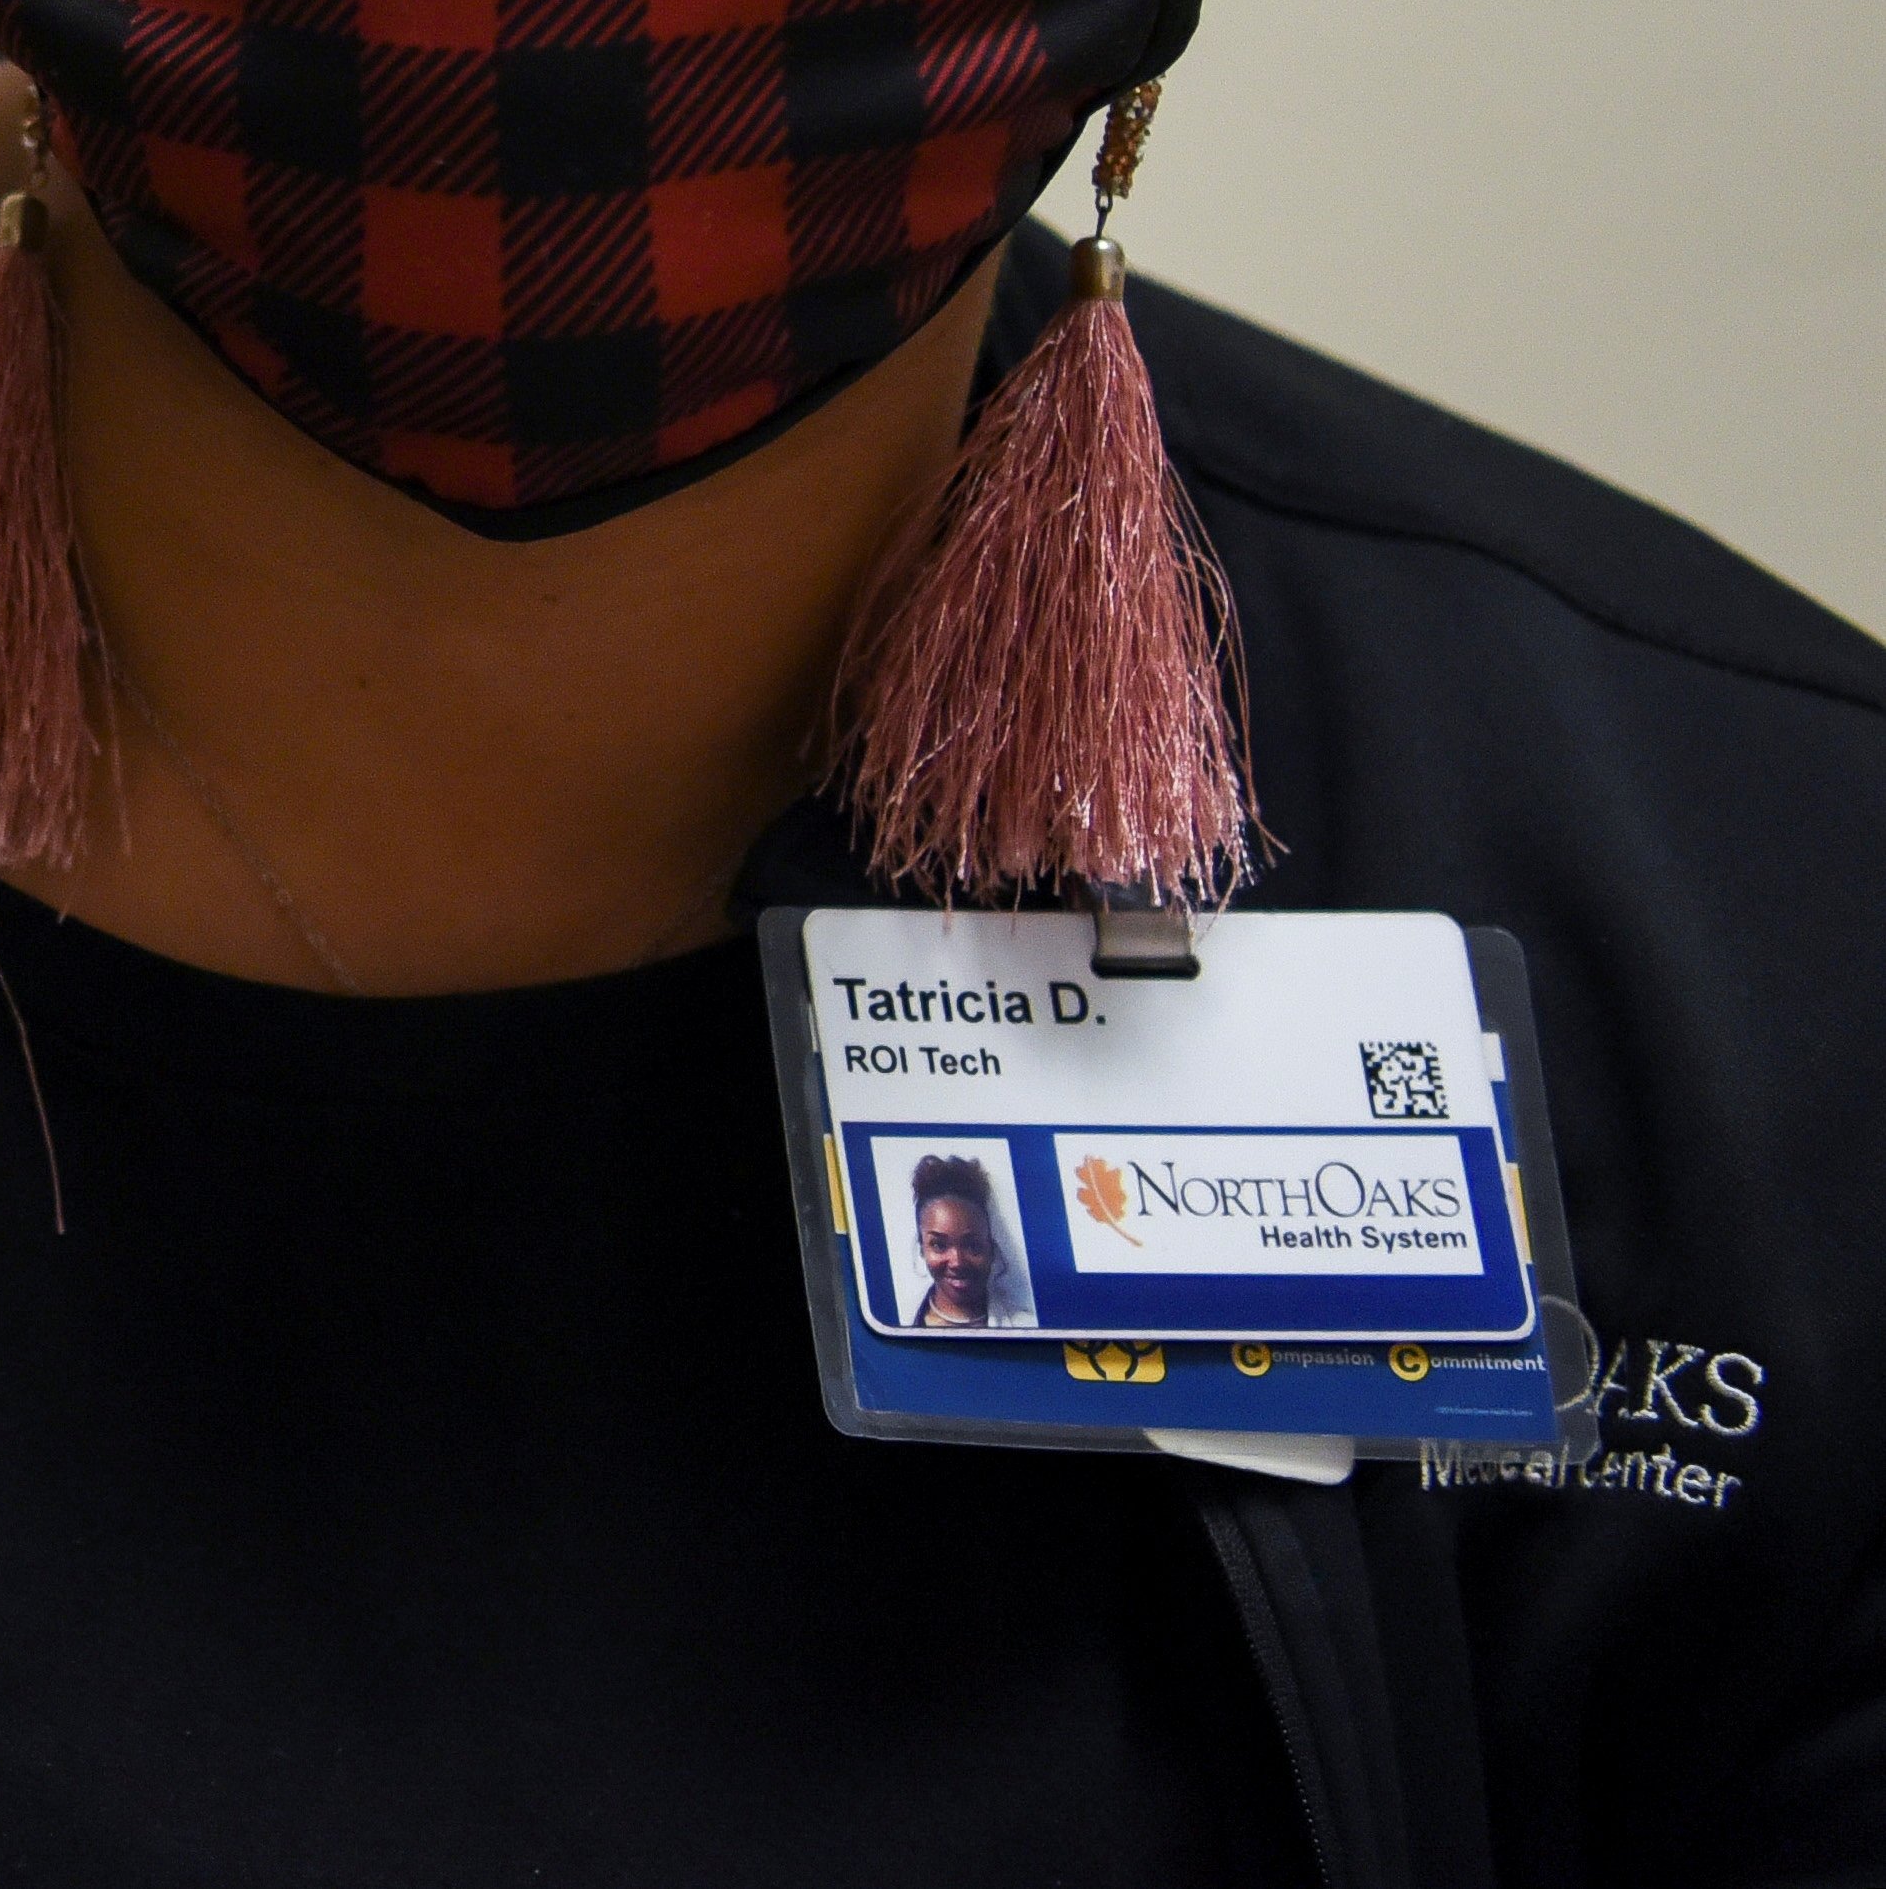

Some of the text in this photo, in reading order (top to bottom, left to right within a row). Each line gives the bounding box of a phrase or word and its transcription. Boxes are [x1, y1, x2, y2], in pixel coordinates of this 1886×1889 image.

[832, 976, 1108, 1026] Tatricia D.
[844, 1044, 1003, 1076] ROI Tech
[1260, 1225, 1468, 1255] Health System
[1395, 1343, 1547, 1378] Commitment
